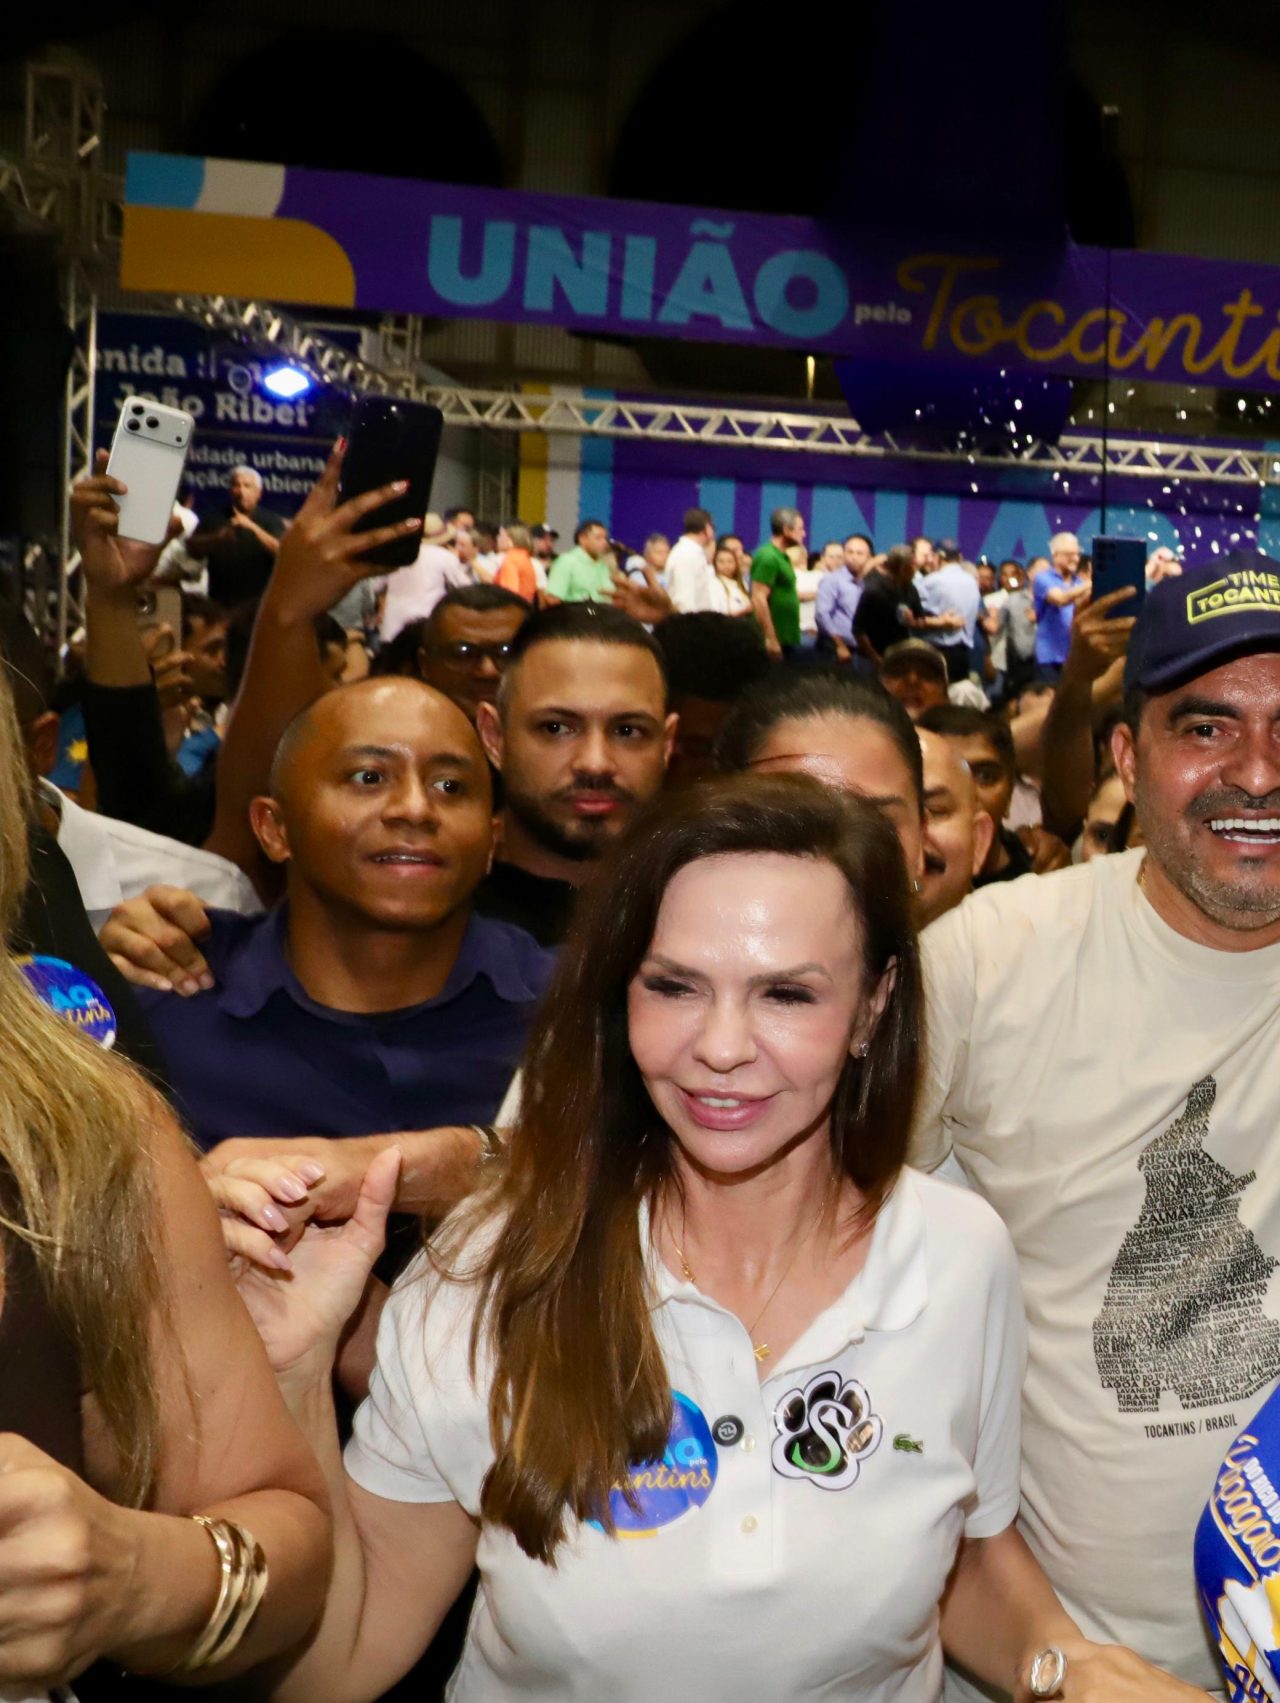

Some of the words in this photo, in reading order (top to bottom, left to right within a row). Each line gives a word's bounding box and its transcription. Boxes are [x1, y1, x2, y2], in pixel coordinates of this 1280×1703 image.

[427, 214, 849, 338] UNIÃO
[855, 301, 912, 325] pelo
[97, 344, 186, 377] nida
[1228, 570, 1280, 588] TIME
[1138, 1203, 1196, 1225] PALMAS
[1212, 1311, 1236, 1321] NOVO
[1238, 1309, 1250, 1317] DO
[1251, 1306, 1262, 1314] TO
[1217, 1298, 1263, 1312] TUPIRAMA
[1244, 1318, 1279, 1331] AFONSO
[1179, 1385, 1239, 1401] PEQUIZEIRO
[1181, 1392, 1250, 1410] WANDERLÂNDIA
[1144, 1421, 1196, 1438] TOCANTINS
[1205, 1413, 1238, 1432] BRASIL
